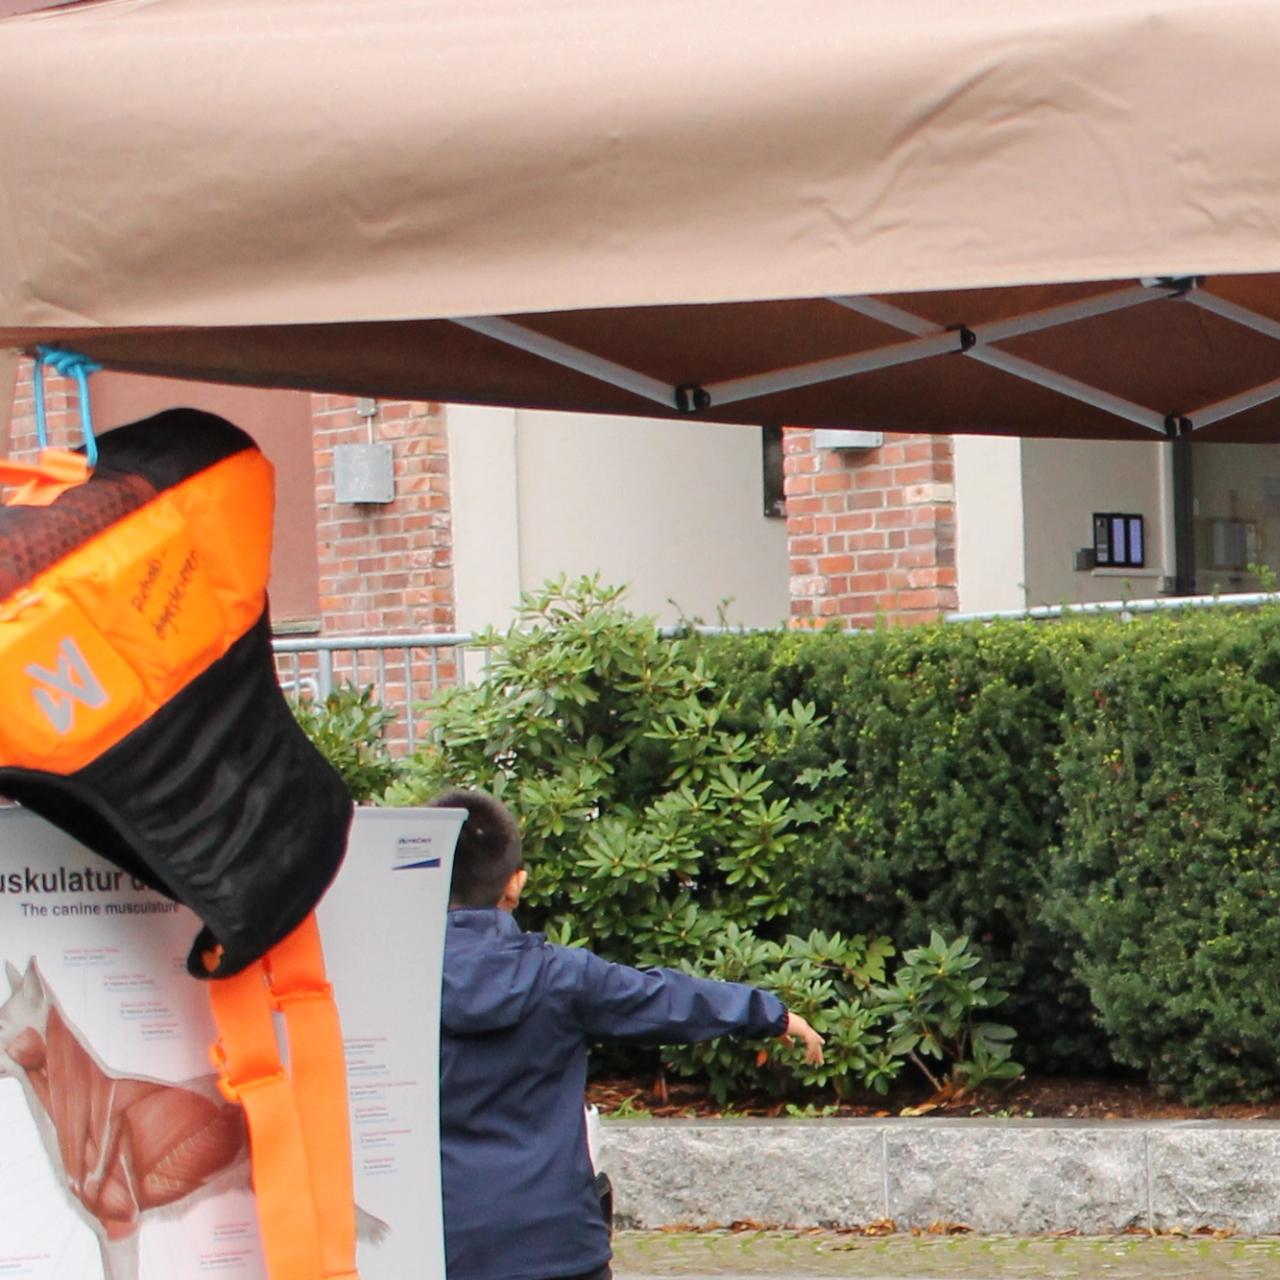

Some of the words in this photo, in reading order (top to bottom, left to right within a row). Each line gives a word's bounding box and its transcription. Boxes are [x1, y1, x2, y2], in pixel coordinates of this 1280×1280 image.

[0, 867, 123, 894] skulatur
[21, 903, 48, 917] The
[52, 902, 101, 917] canine
[105, 901, 180, 914] musculature
